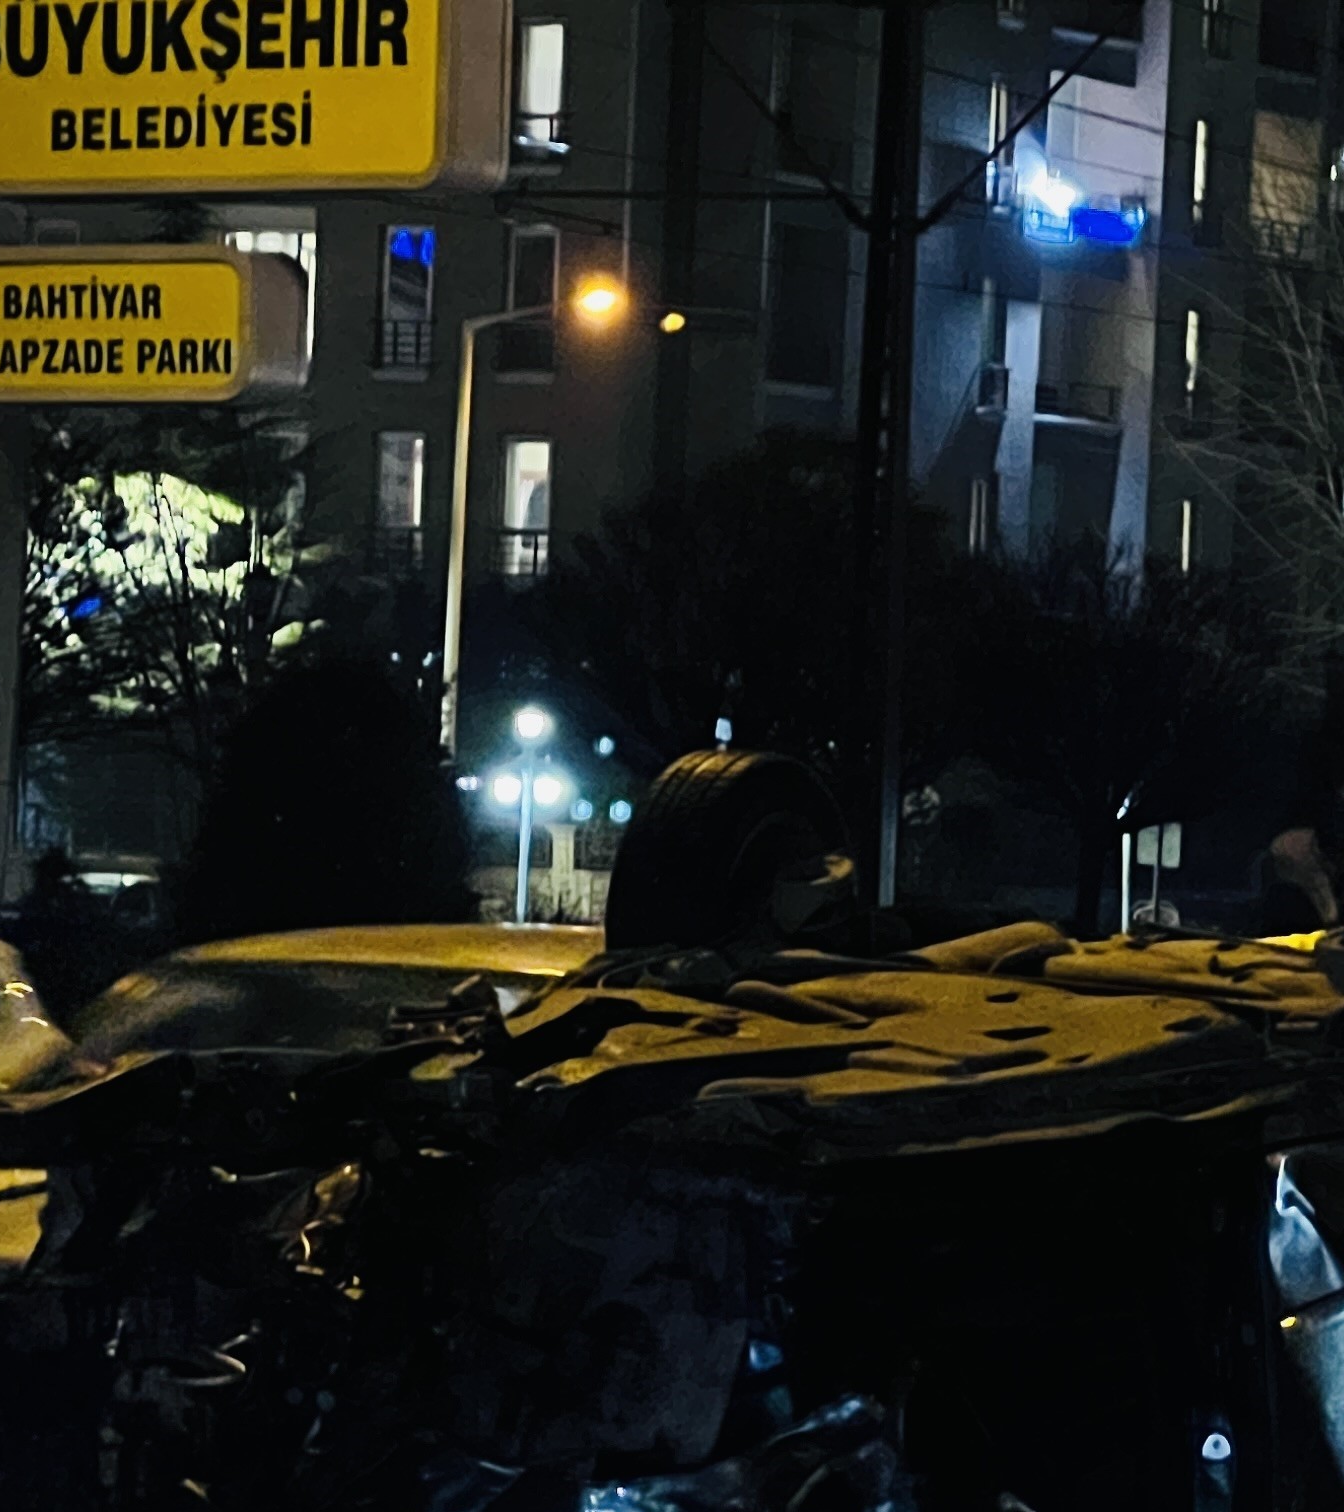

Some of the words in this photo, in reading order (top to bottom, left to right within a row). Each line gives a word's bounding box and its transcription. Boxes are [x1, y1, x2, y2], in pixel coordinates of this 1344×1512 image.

[51, 90, 312, 151] BELEDİYESİ
[3, 276, 161, 320] BAHTİYAR
[137, 339, 232, 374] PARKI
